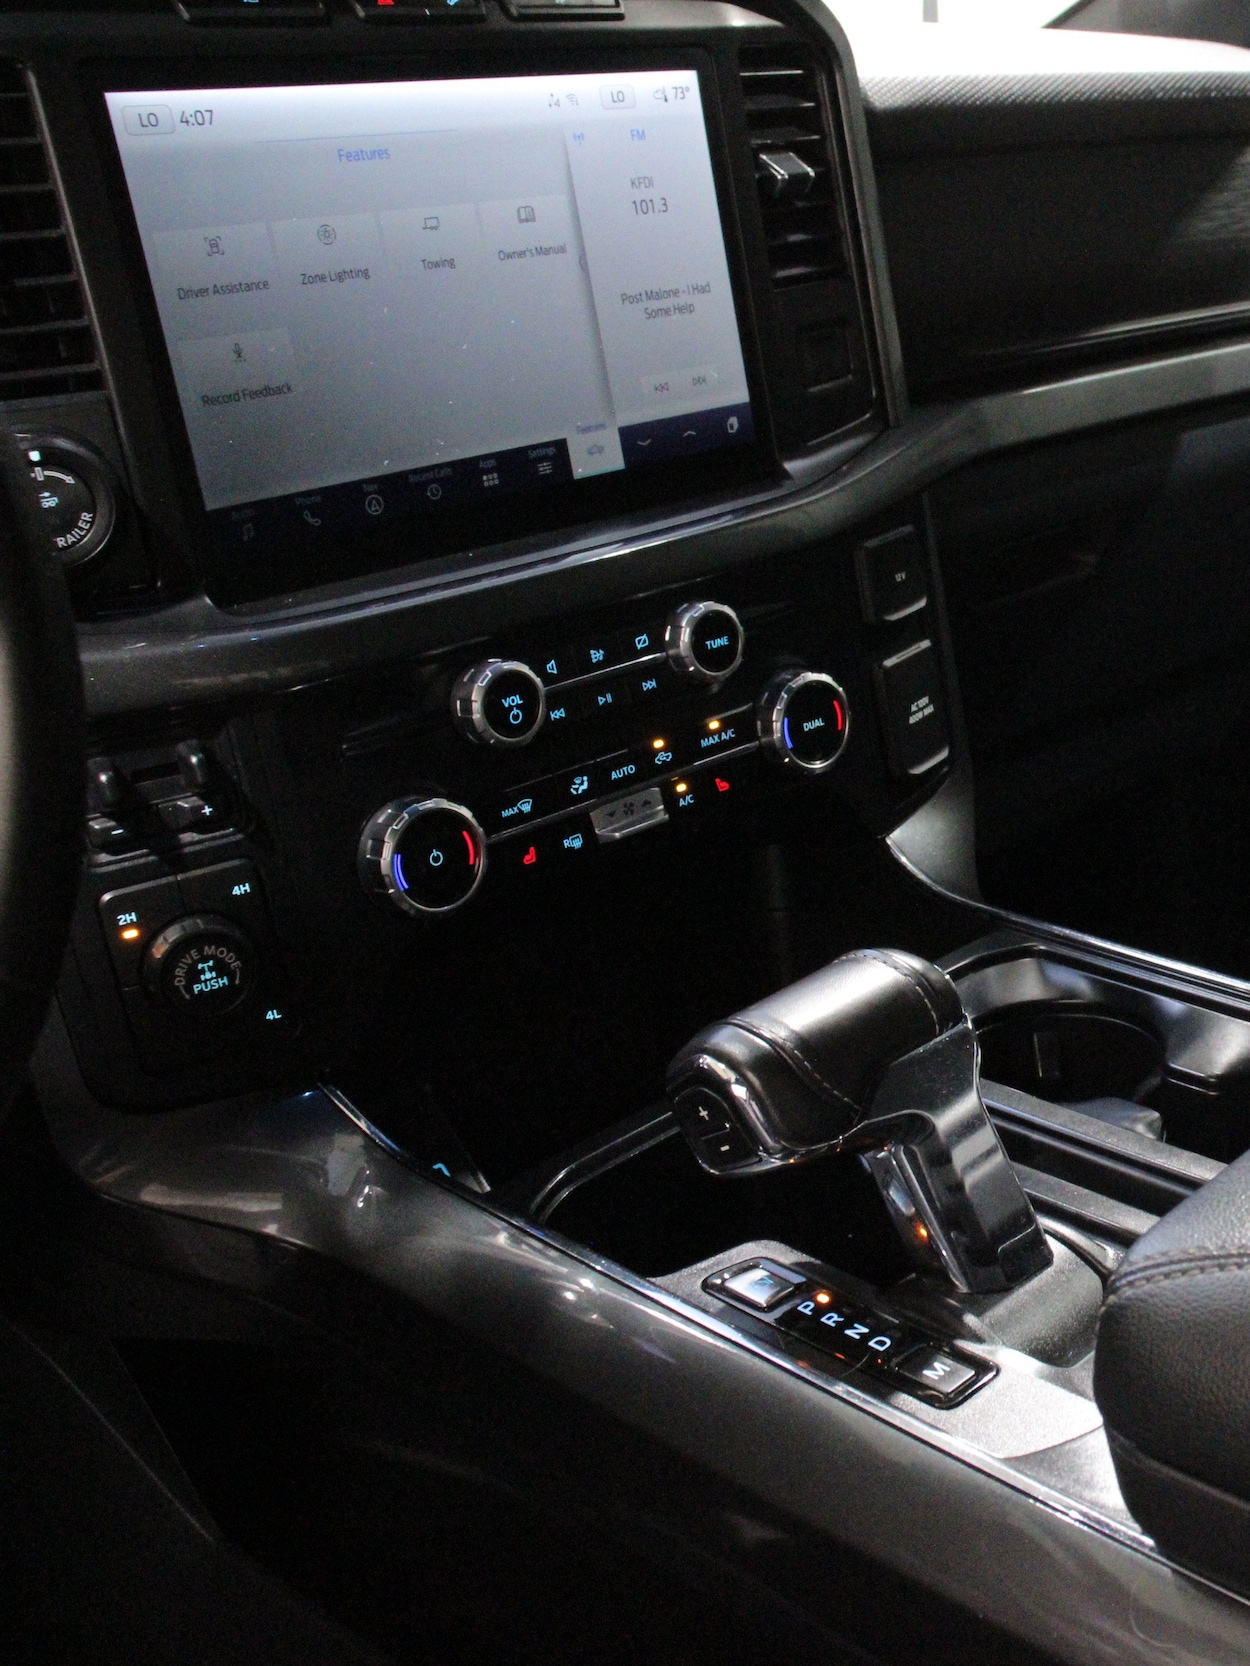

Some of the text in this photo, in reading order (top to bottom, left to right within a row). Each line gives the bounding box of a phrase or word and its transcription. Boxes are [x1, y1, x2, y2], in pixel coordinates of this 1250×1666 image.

[611, 91, 625, 104] LO
[138, 112, 159, 128] LO
[179, 110, 214, 126] 4:07
[630, 130, 647, 142] FM
[337, 147, 391, 163] Features
[630, 176, 654, 189] KFDI
[631, 197, 669, 216] 101.3
[498, 243, 568, 262] Owner's Manual
[420, 257, 456, 272] Towing
[300, 266, 371, 285] Zone Lighting
[177, 278, 270, 301] Driver Assistance
[621, 291, 644, 306] Post
[644, 286, 681, 302] Malone
[692, 282, 711, 296] Had
[644, 302, 696, 320] Some Help
[201, 382, 294, 408] Record Feedback
[54, 512, 94, 548] RAILER
[705, 636, 729, 650] TUNE
[502, 694, 523, 708] VOL
[803, 717, 825, 732] DUAL
[700, 728, 736, 749] MAX A/C
[610, 764, 636, 781] AUTO
[679, 793, 694, 807] A/C
[502, 805, 519, 818] MAX
[231, 882, 251, 897] 4H
[116, 911, 138, 926] 2H
[174, 945, 242, 987] DRIVE MODE
[193, 975, 230, 995] PUSH
[265, 1009, 283, 1021] 4L
[797, 1301, 892, 1352] P R N D
[922, 1360, 951, 1380] M
